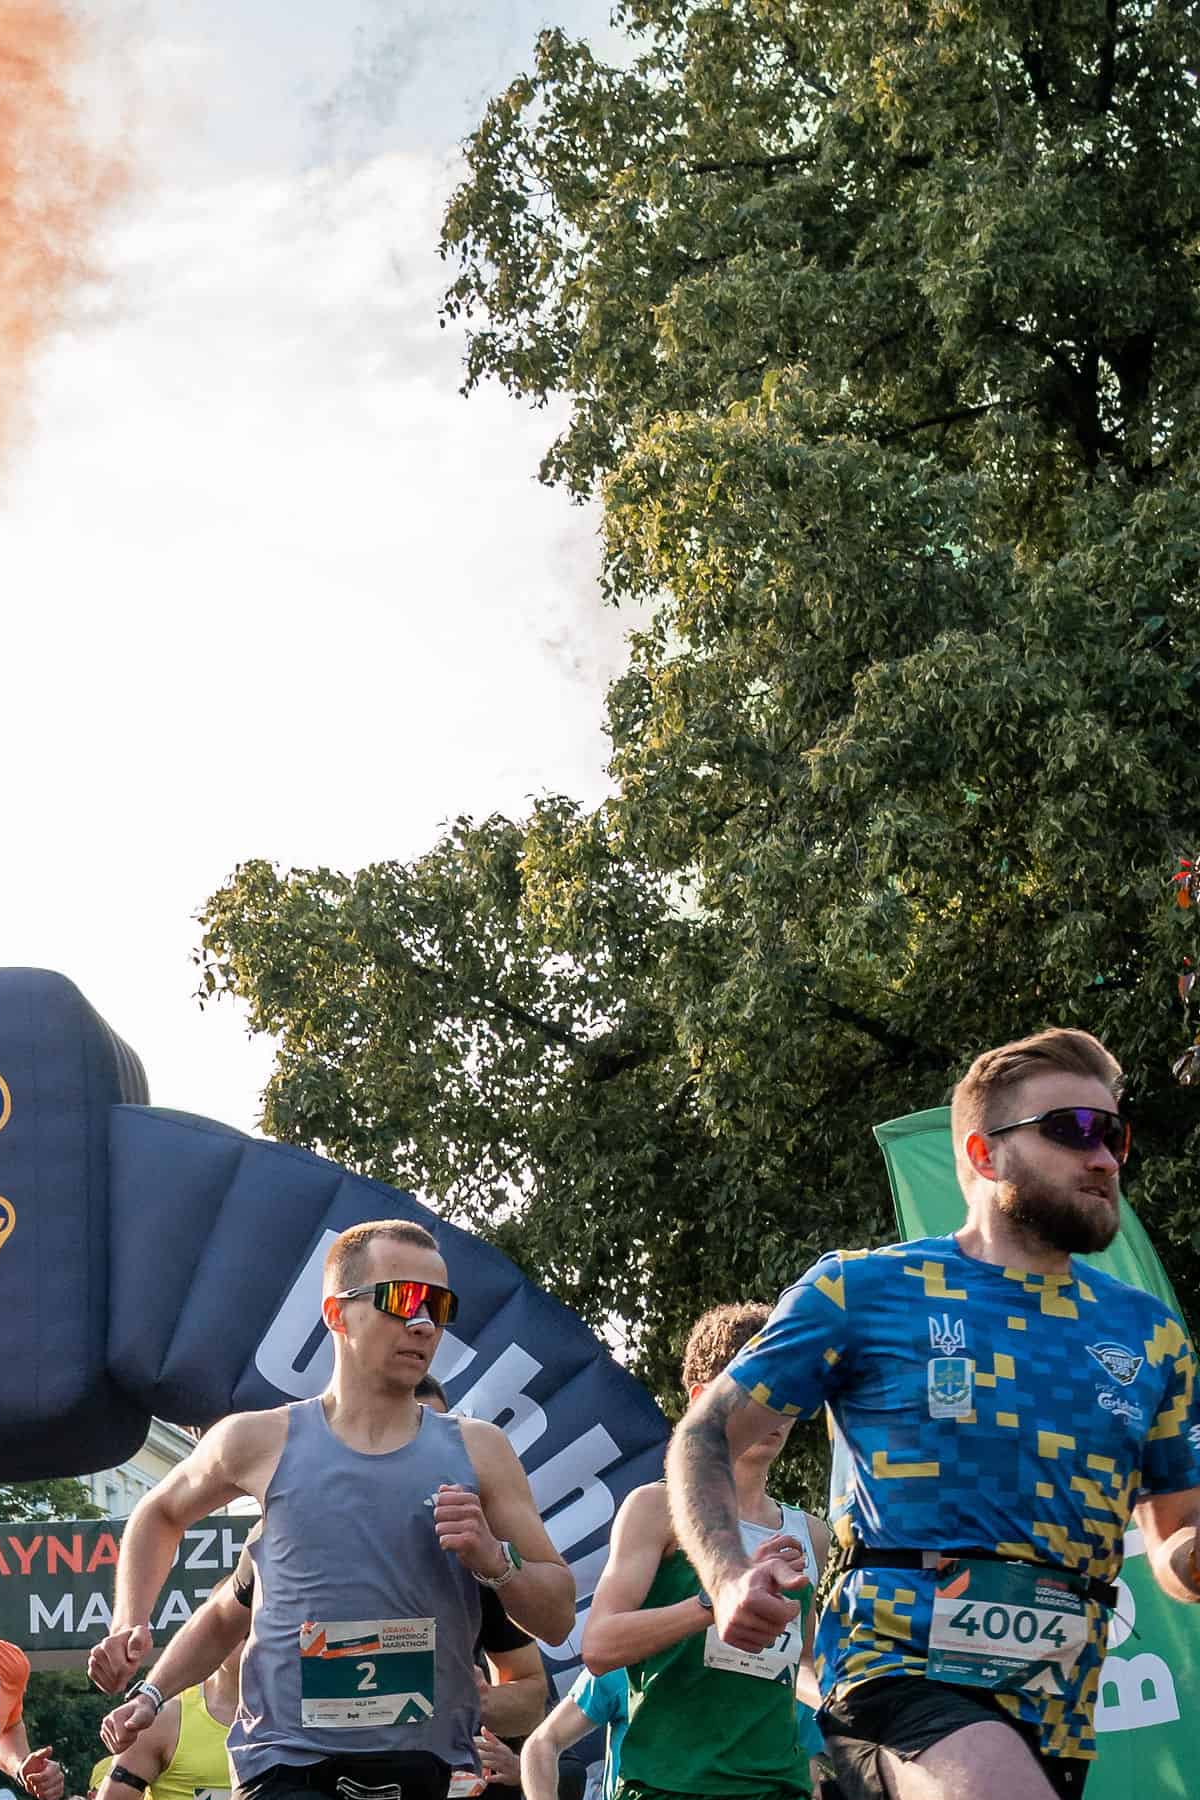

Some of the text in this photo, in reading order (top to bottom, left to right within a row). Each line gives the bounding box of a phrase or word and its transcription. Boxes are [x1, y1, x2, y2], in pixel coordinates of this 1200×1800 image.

[949, 1603, 1067, 1648] 4004
[767, 1631, 791, 1652] 7
[355, 1662, 377, 1690] 2
